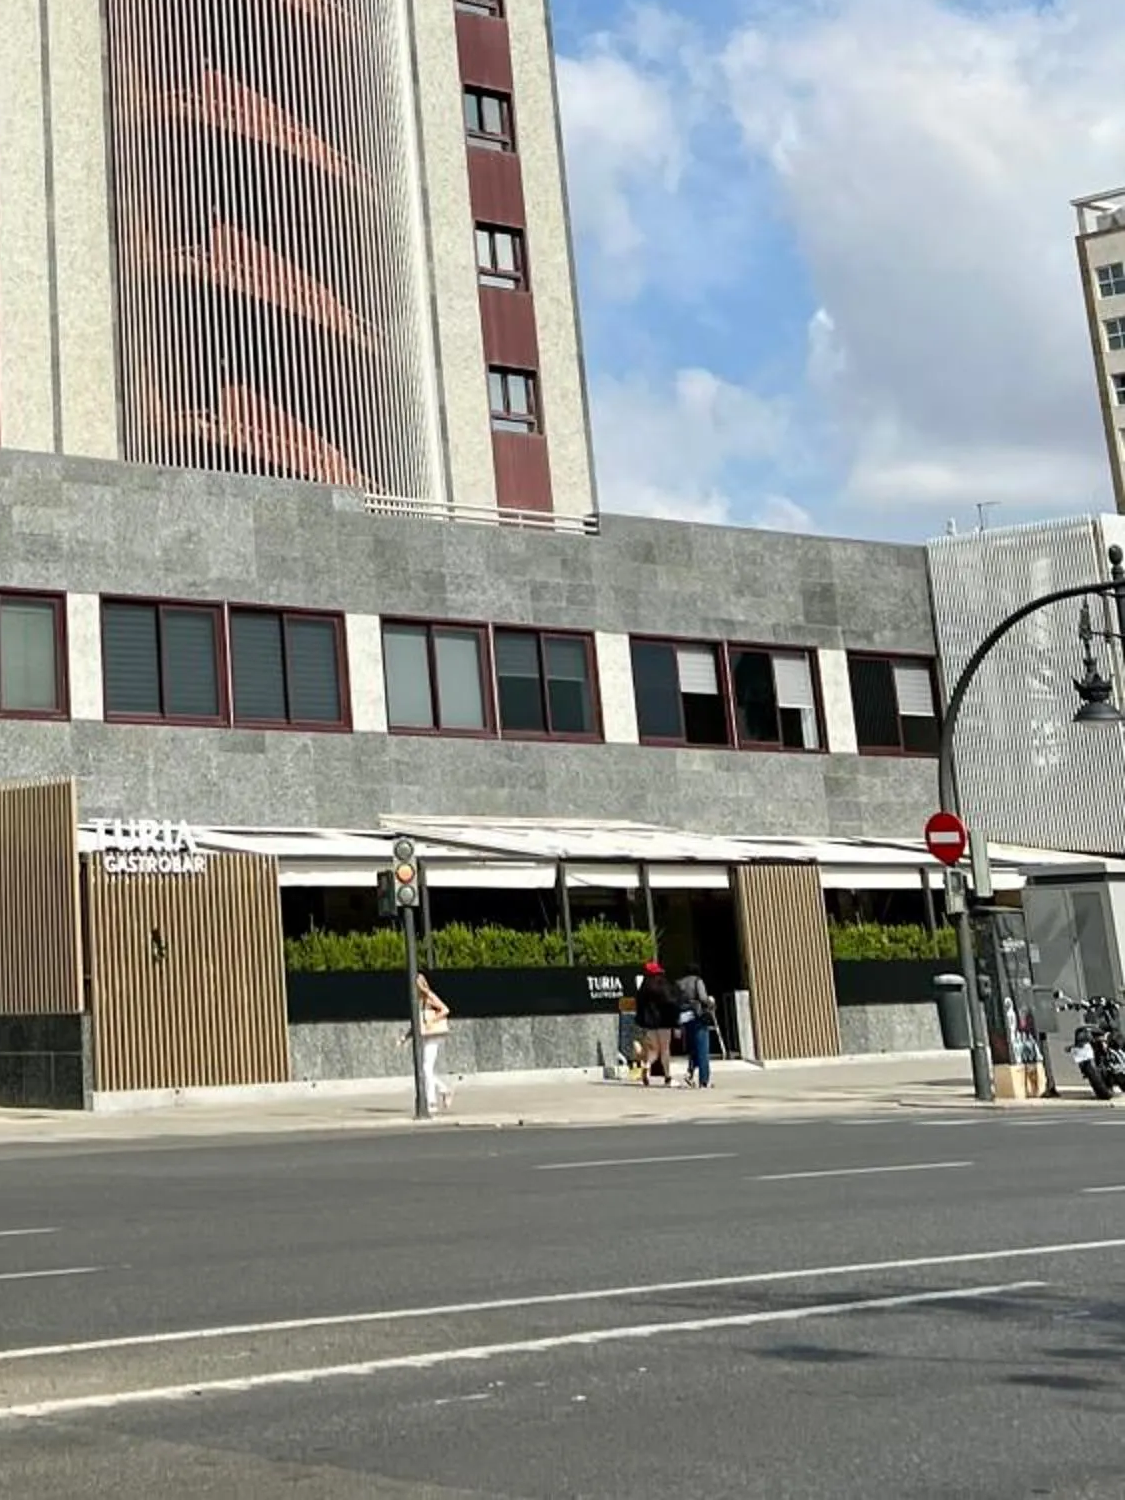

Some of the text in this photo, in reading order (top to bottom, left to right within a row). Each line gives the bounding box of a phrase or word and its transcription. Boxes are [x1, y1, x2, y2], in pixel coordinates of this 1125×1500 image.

[88, 818, 196, 852] TURIA
[104, 854, 207, 873] GASTROBAR
[587, 975, 623, 990] TURIA
